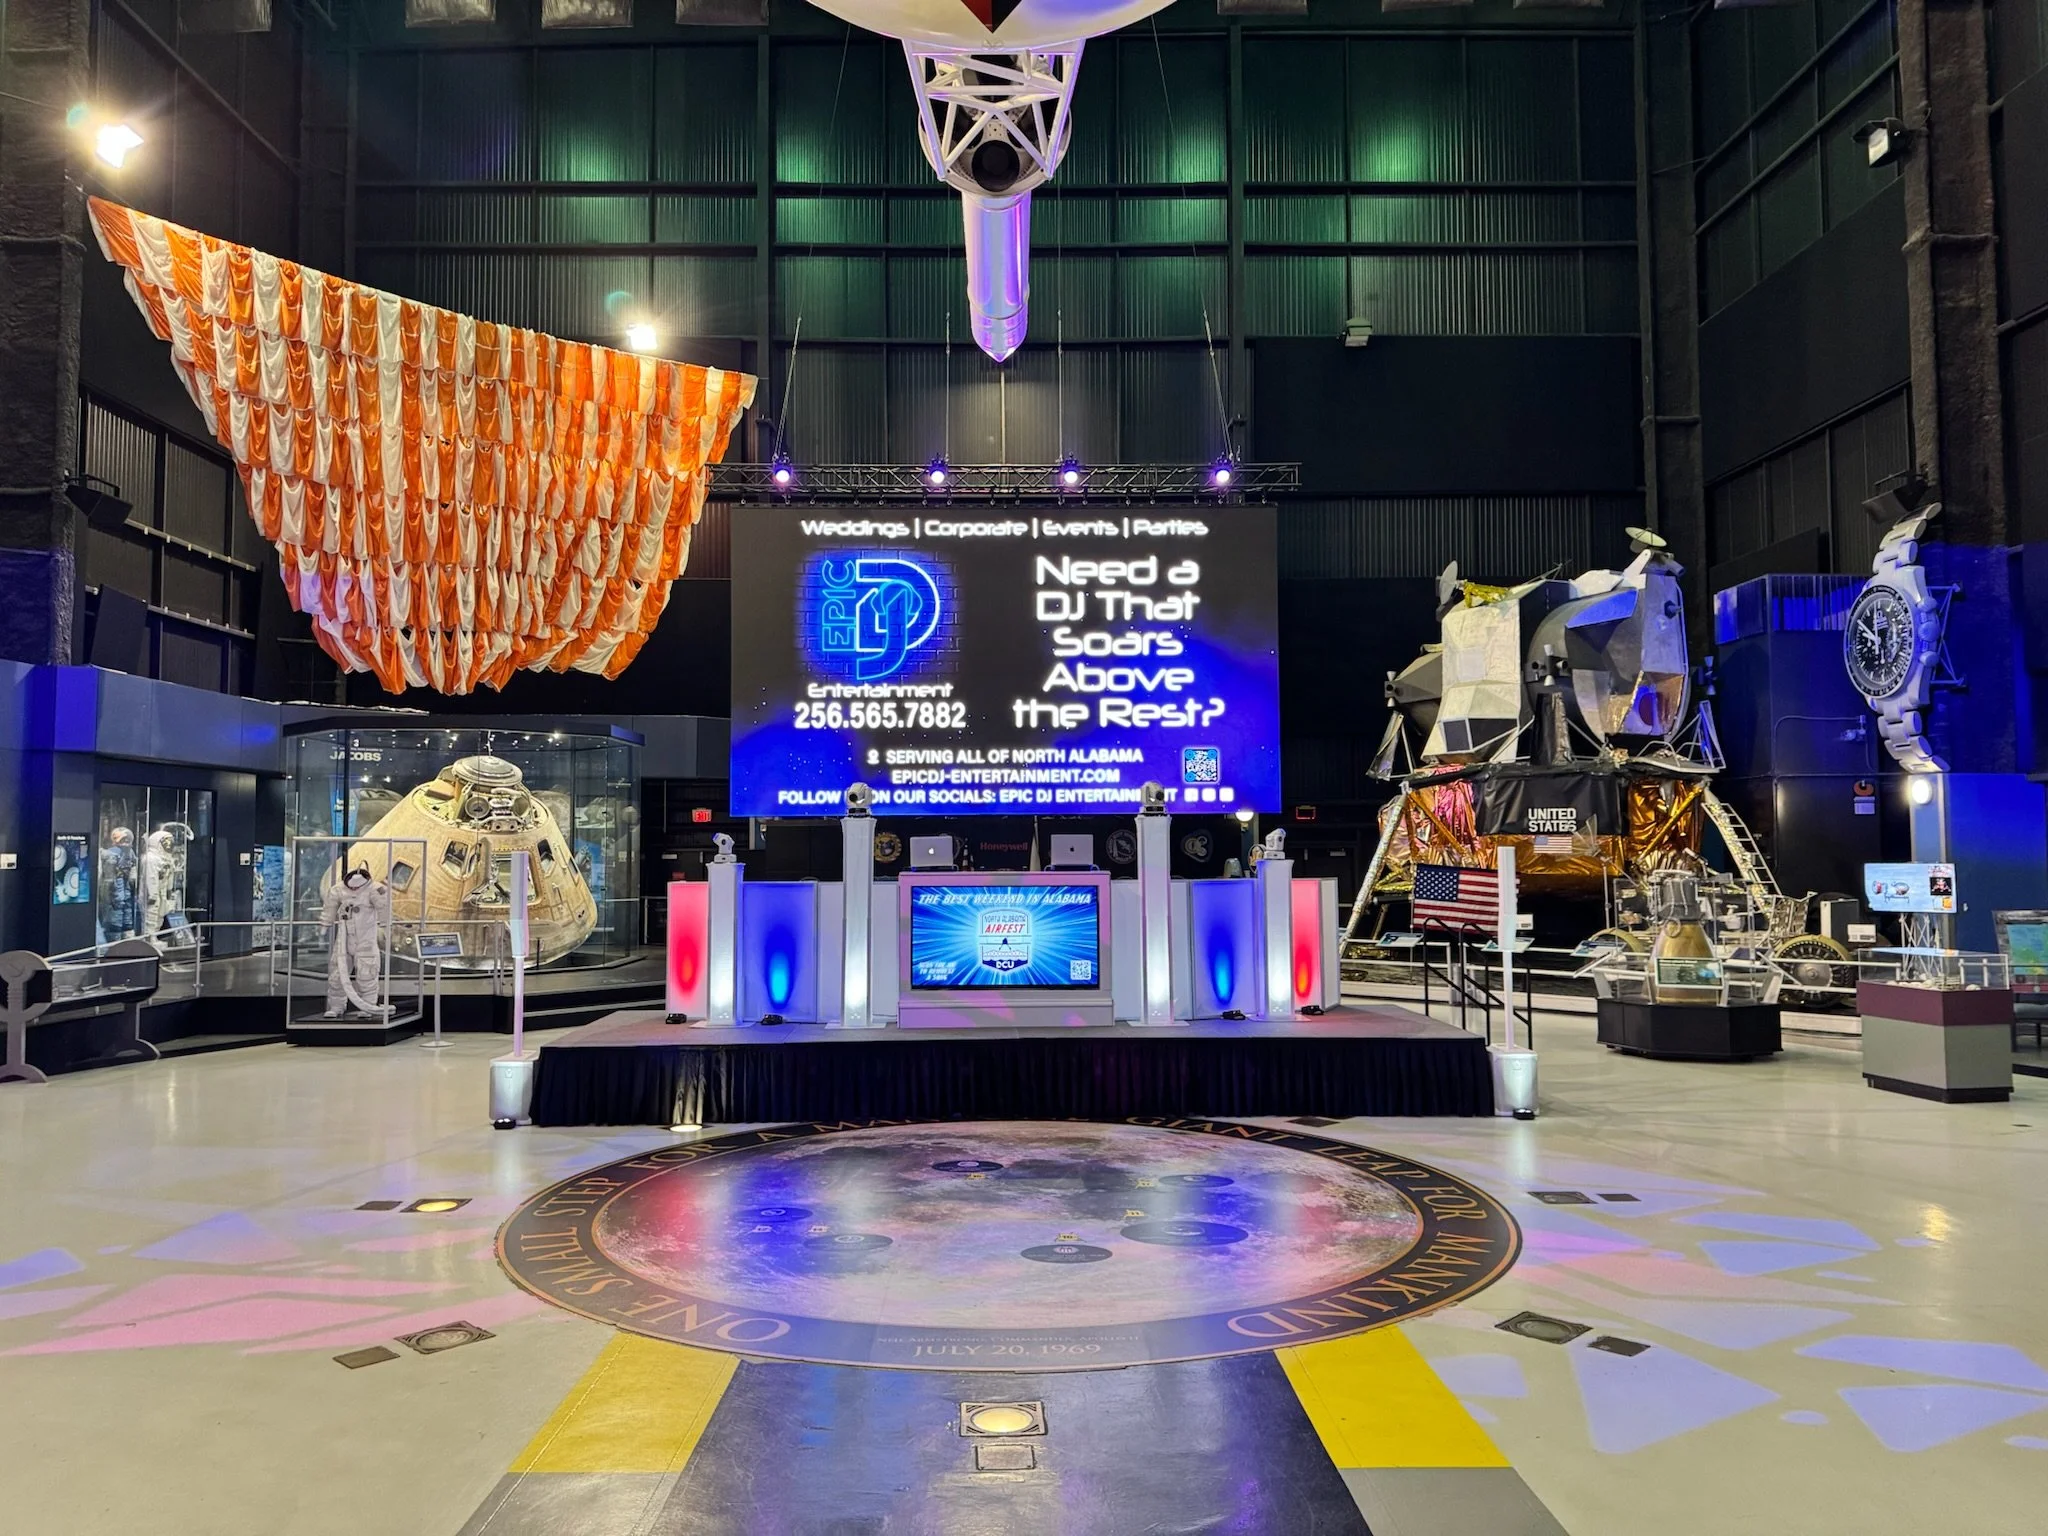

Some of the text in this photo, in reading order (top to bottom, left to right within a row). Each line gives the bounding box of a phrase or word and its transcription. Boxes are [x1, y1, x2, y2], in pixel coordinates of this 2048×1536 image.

[801, 519, 910, 538] Weddings
[924, 519, 1029, 538] Corporate
[1042, 519, 1120, 537] Events
[1133, 519, 1210, 537] Parties
[1036, 555, 1200, 586] Need a
[822, 560, 857, 651] EPIC
[1036, 591, 1201, 621] DJ That
[1053, 626, 1184, 657] Soars
[807, 683, 954, 698] Entertainment
[1042, 662, 1195, 692] Above
[794, 702, 967, 729] 256.565.7882
[1012, 698, 1226, 728] the Rest?
[886, 748, 1144, 765] SERVING ALL OF NORTH ALABAMA
[891, 769, 1120, 785] EPICDJ-ENTERTAINMENT.COM
[778, 790, 842, 805] FOLLOW
[893, 789, 926, 804] OUR
[929, 789, 996, 804] SOCIALS:
[999, 789, 1033, 804] EPIC
[1036, 788, 1051, 803] DJ
[1055, 788, 1178, 803] ENTERTAINT
[1528, 808, 1577, 820] UNITED
[1529, 820, 1577, 832] STATES
[980, 842, 1029, 852] Honeywell
[919, 894, 942, 905] THE
[942, 894, 971, 904] BEST
[974, 893, 1025, 904] WEEKEND
[1043, 893, 1091, 904] ALABAMA
[985, 924, 1025, 933] AIRFEST
[756, 1131, 794, 1142] A
[1126, 1116, 1305, 1142] GIANT
[621, 1143, 741, 1170] FOR
[1311, 1146, 1430, 1181] LEAP
[532, 1176, 626, 1217] STEP
[1408, 1186, 1488, 1221] FOR
[520, 1227, 634, 1296] SMALL
[1227, 1231, 1495, 1338] MANKIND
[608, 1295, 791, 1342] ONE
[912, 1343, 1101, 1357] JULY 20, 1969
